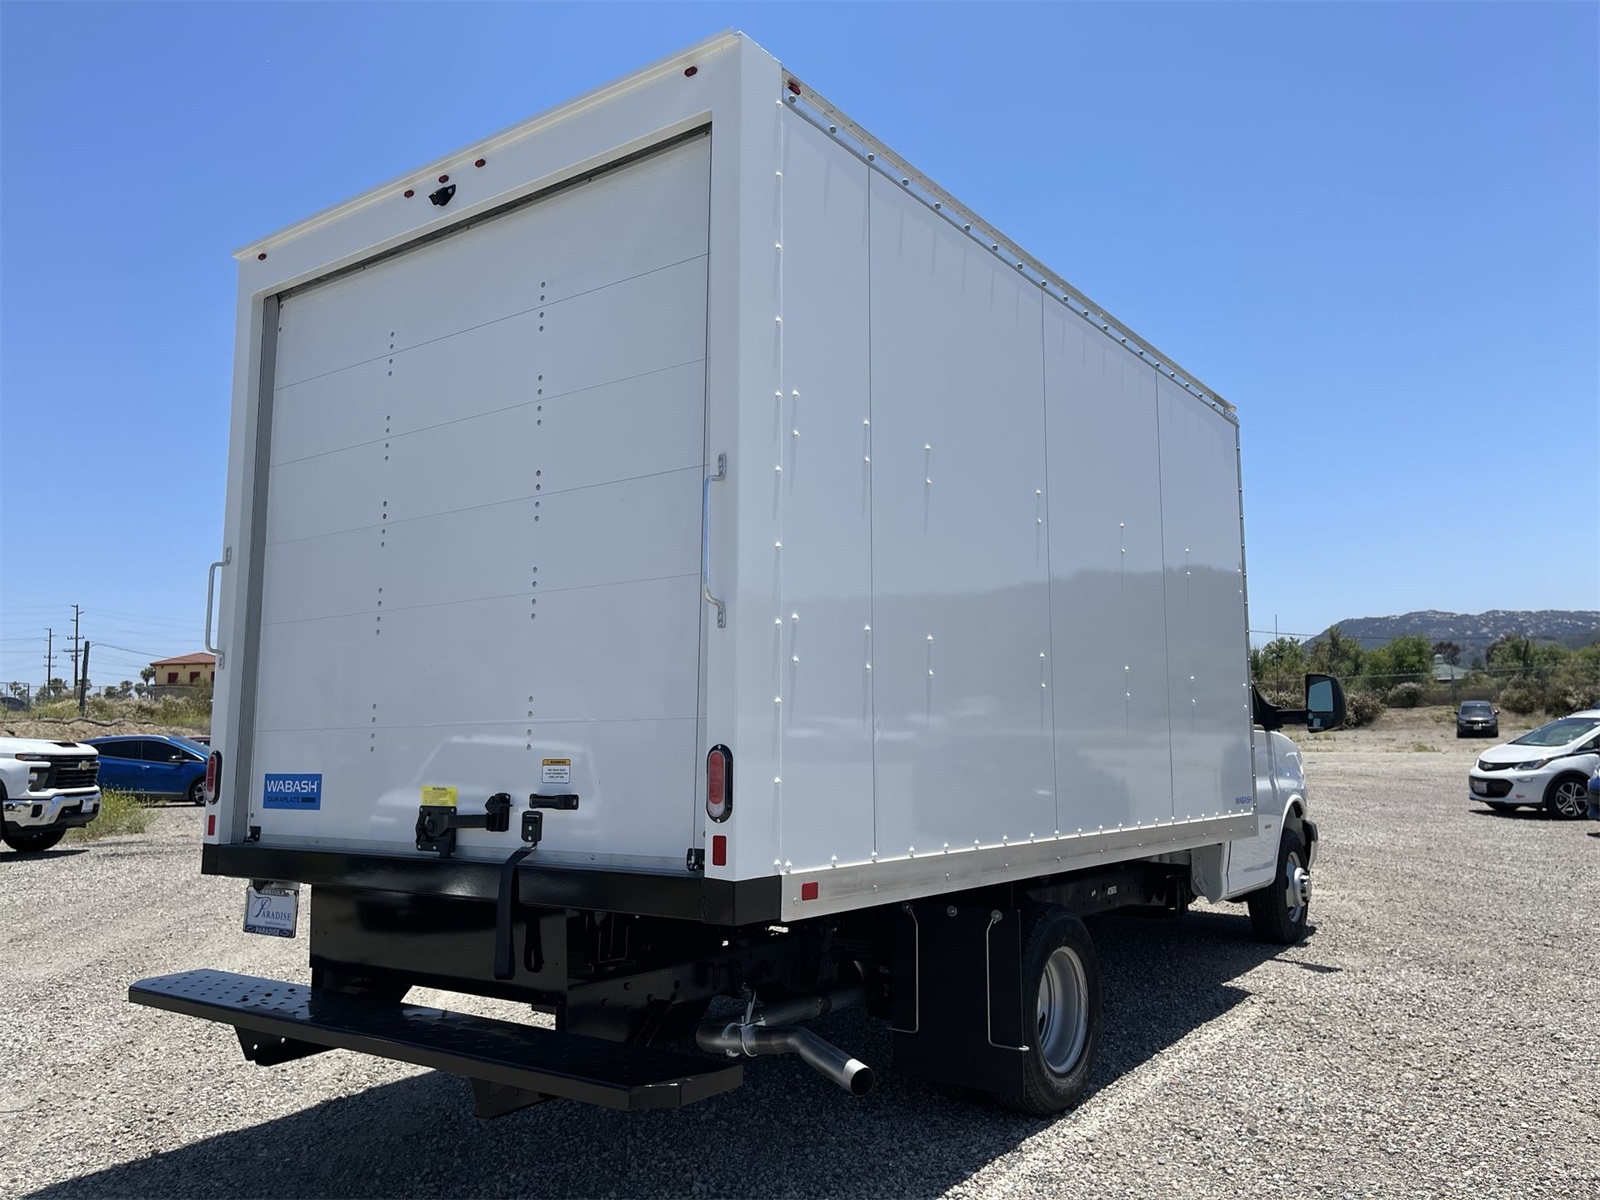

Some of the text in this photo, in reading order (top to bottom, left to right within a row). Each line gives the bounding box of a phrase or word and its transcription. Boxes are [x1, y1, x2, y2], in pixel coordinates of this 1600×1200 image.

[266, 780, 317, 793] WABASH
[1235, 796, 1253, 805] WABASH
[252, 895, 292, 921] PARADISE
[255, 926, 280, 936] PARADISE
